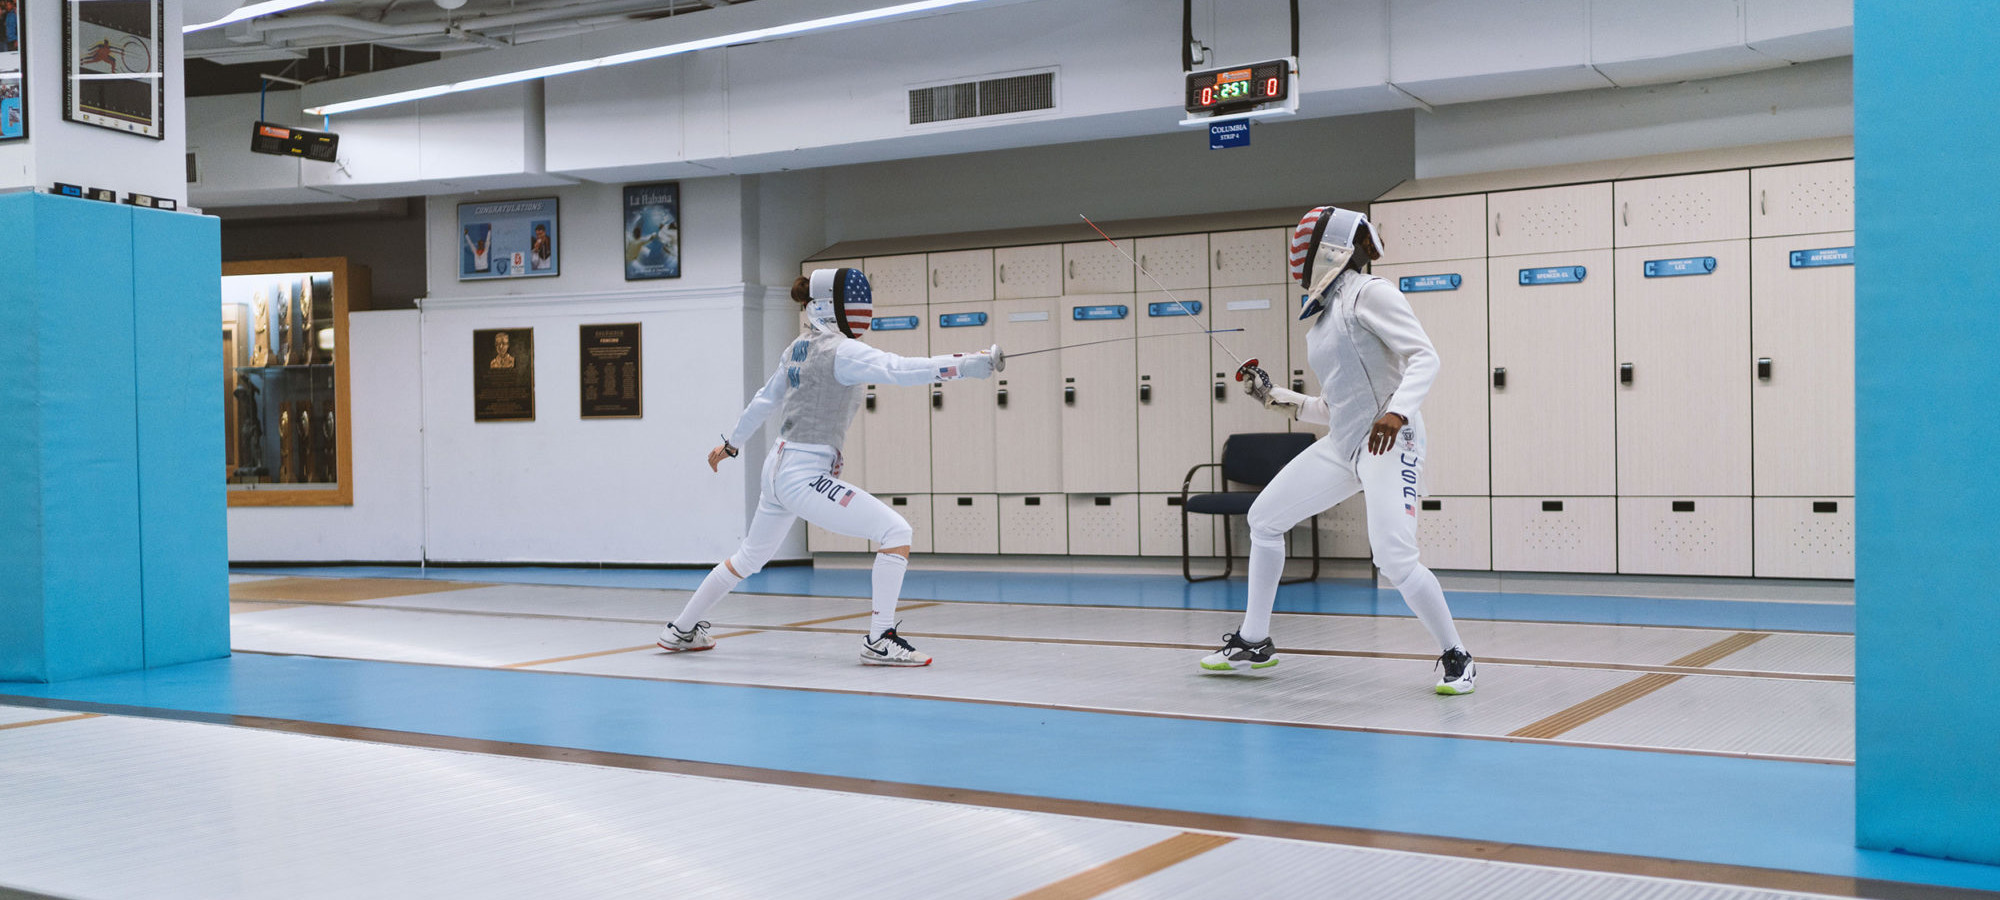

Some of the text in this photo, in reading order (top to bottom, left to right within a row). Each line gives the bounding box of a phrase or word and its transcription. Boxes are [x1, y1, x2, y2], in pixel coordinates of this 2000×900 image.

[1201, 77, 1278, 105] 0 2:57 0
[1211, 124, 1248, 134] COLUMBIA
[630, 193, 672, 206] La Habana
[809, 475, 845, 502] USA
[1401, 452, 1418, 501] USA
